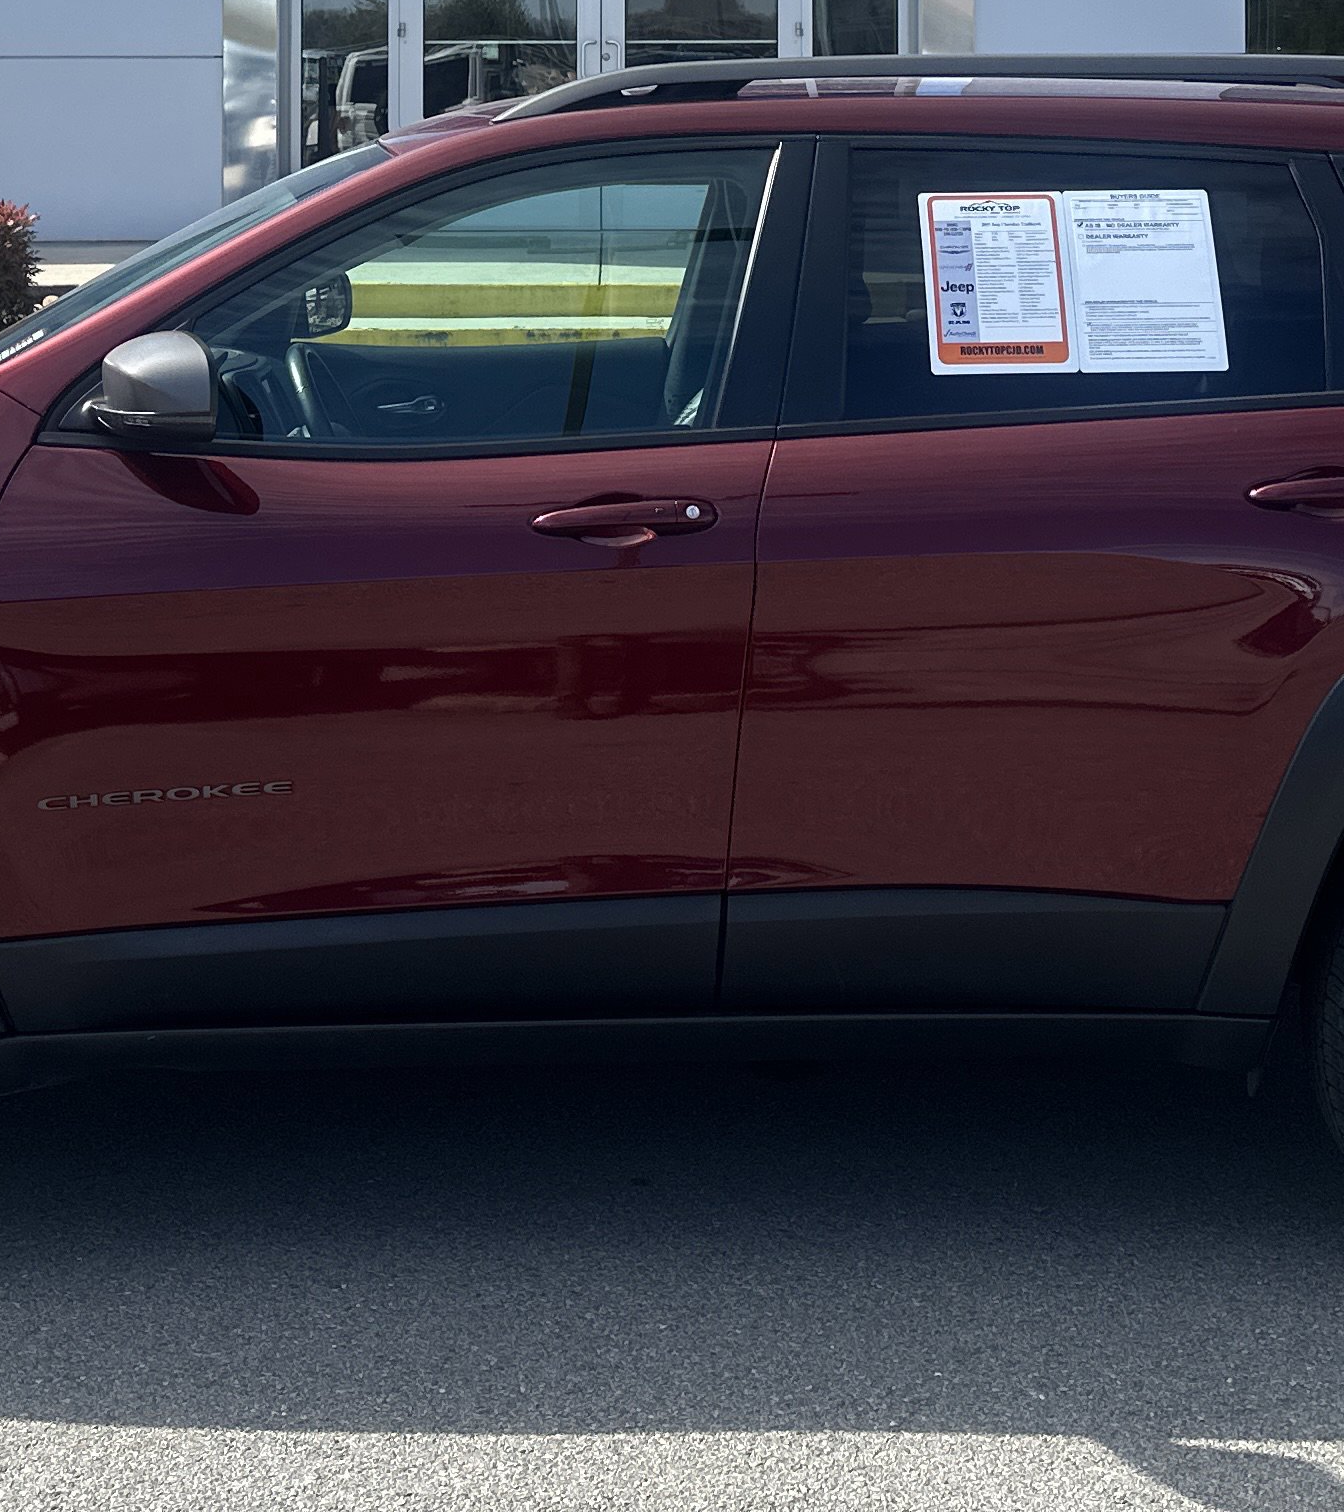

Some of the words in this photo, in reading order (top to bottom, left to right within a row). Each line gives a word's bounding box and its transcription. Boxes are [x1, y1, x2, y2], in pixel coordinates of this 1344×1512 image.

[941, 281, 975, 294] Jeep
[959, 345, 1045, 356] ROCKYTOPCJD.COM
[37, 781, 293, 811] CHEROKEE
